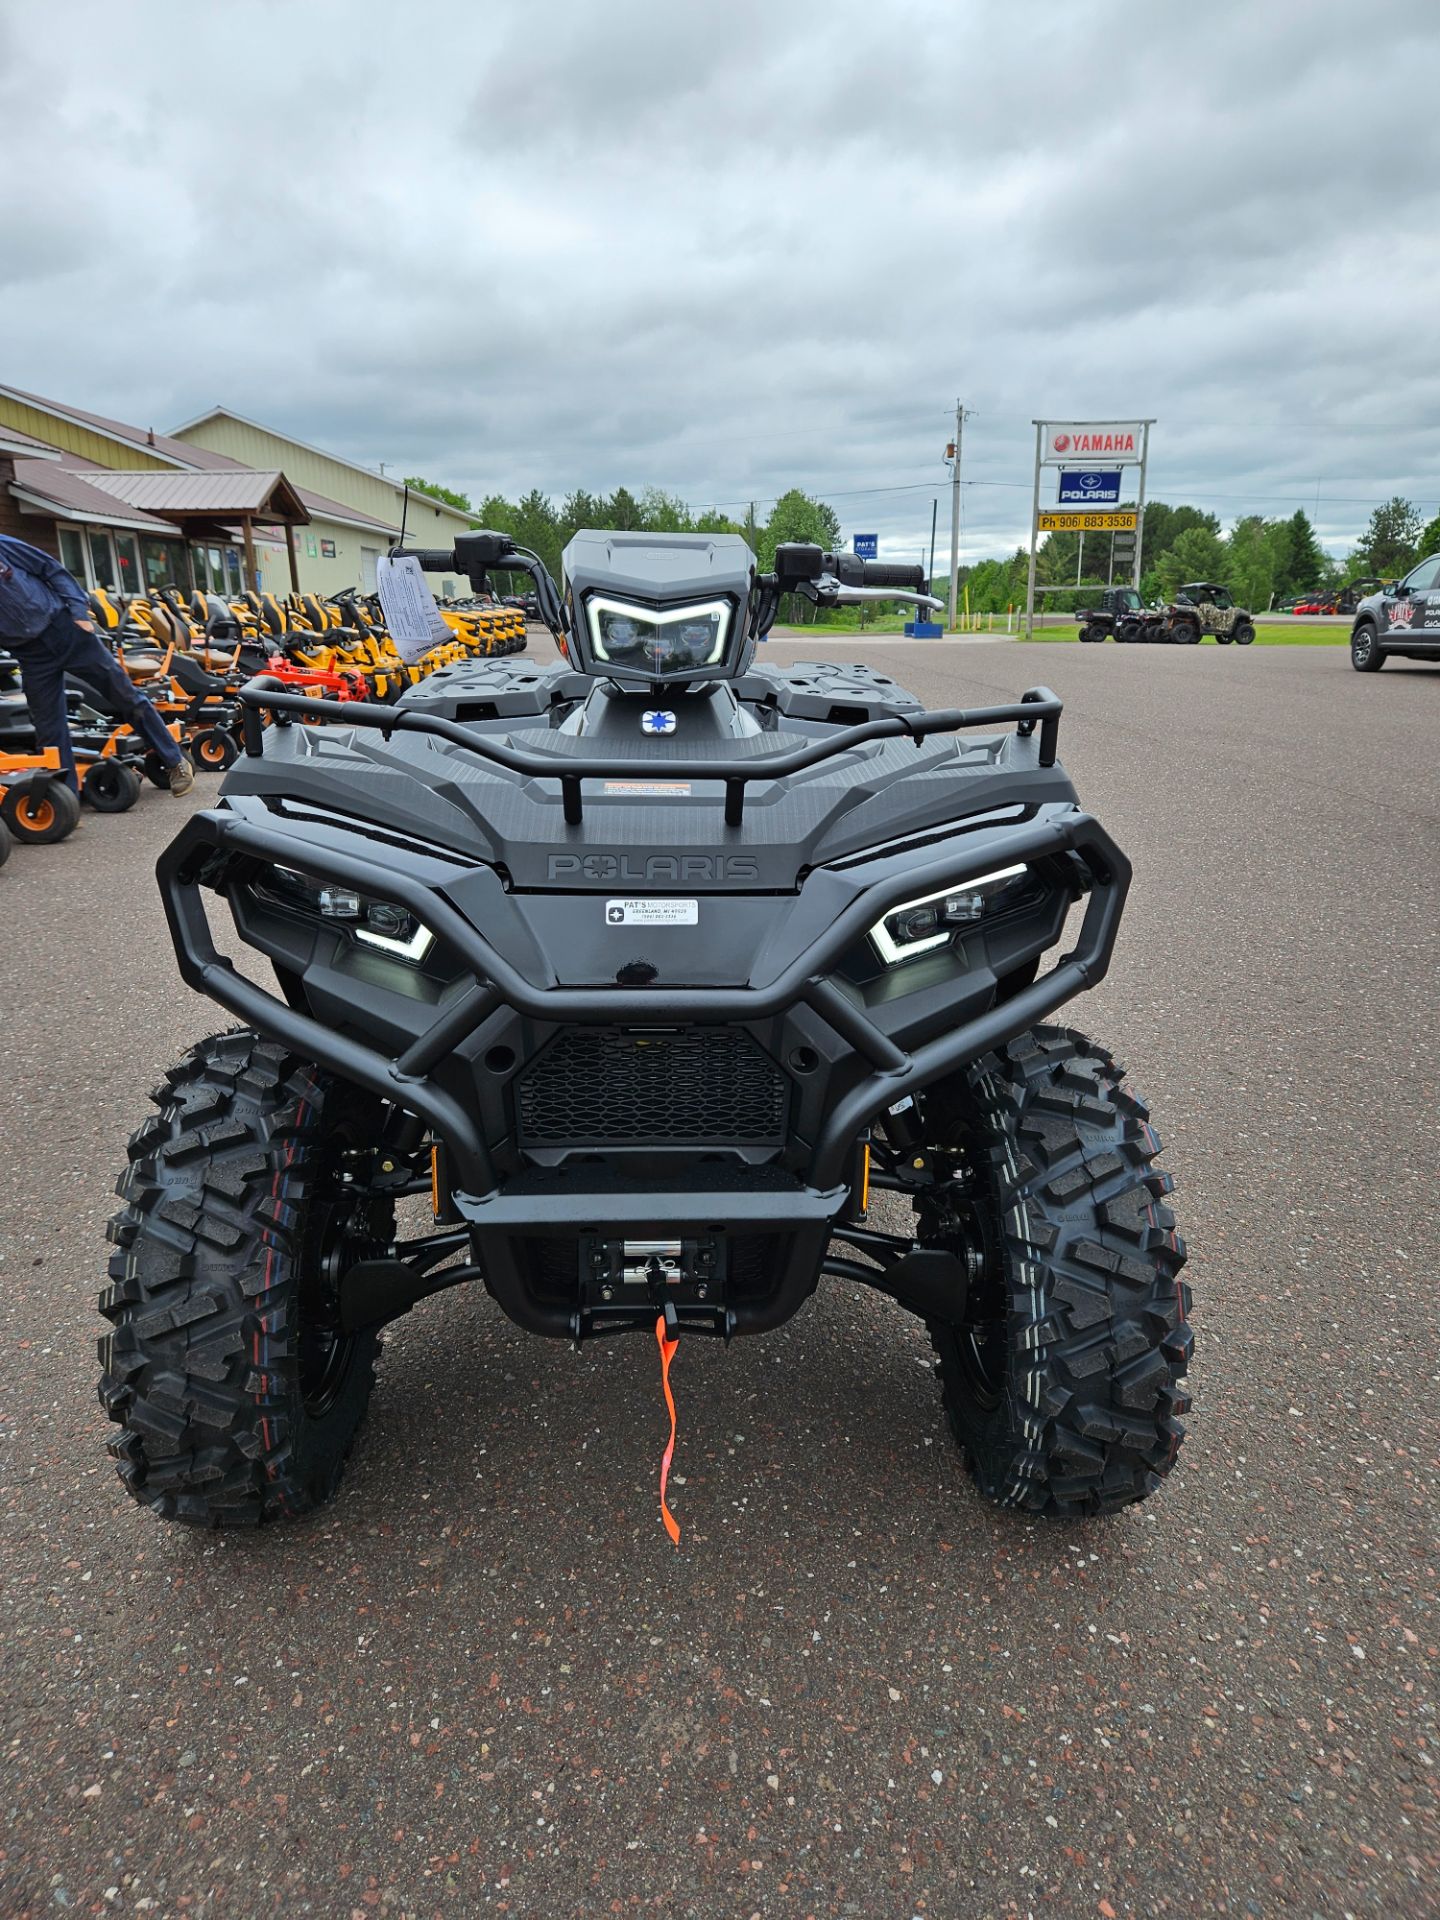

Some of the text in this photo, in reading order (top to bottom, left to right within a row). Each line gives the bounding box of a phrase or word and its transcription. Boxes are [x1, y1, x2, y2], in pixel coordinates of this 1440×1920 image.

[1072, 434, 1135, 451] YAMAHA
[1061, 490, 1117, 500] POLARIS
[1042, 517, 1055, 528] Ph
[1084, 515, 1133, 527] 883-3536
[547, 853, 760, 881] POLARIS
[624, 901, 697, 909] PAT'S MOTORSPORTS
